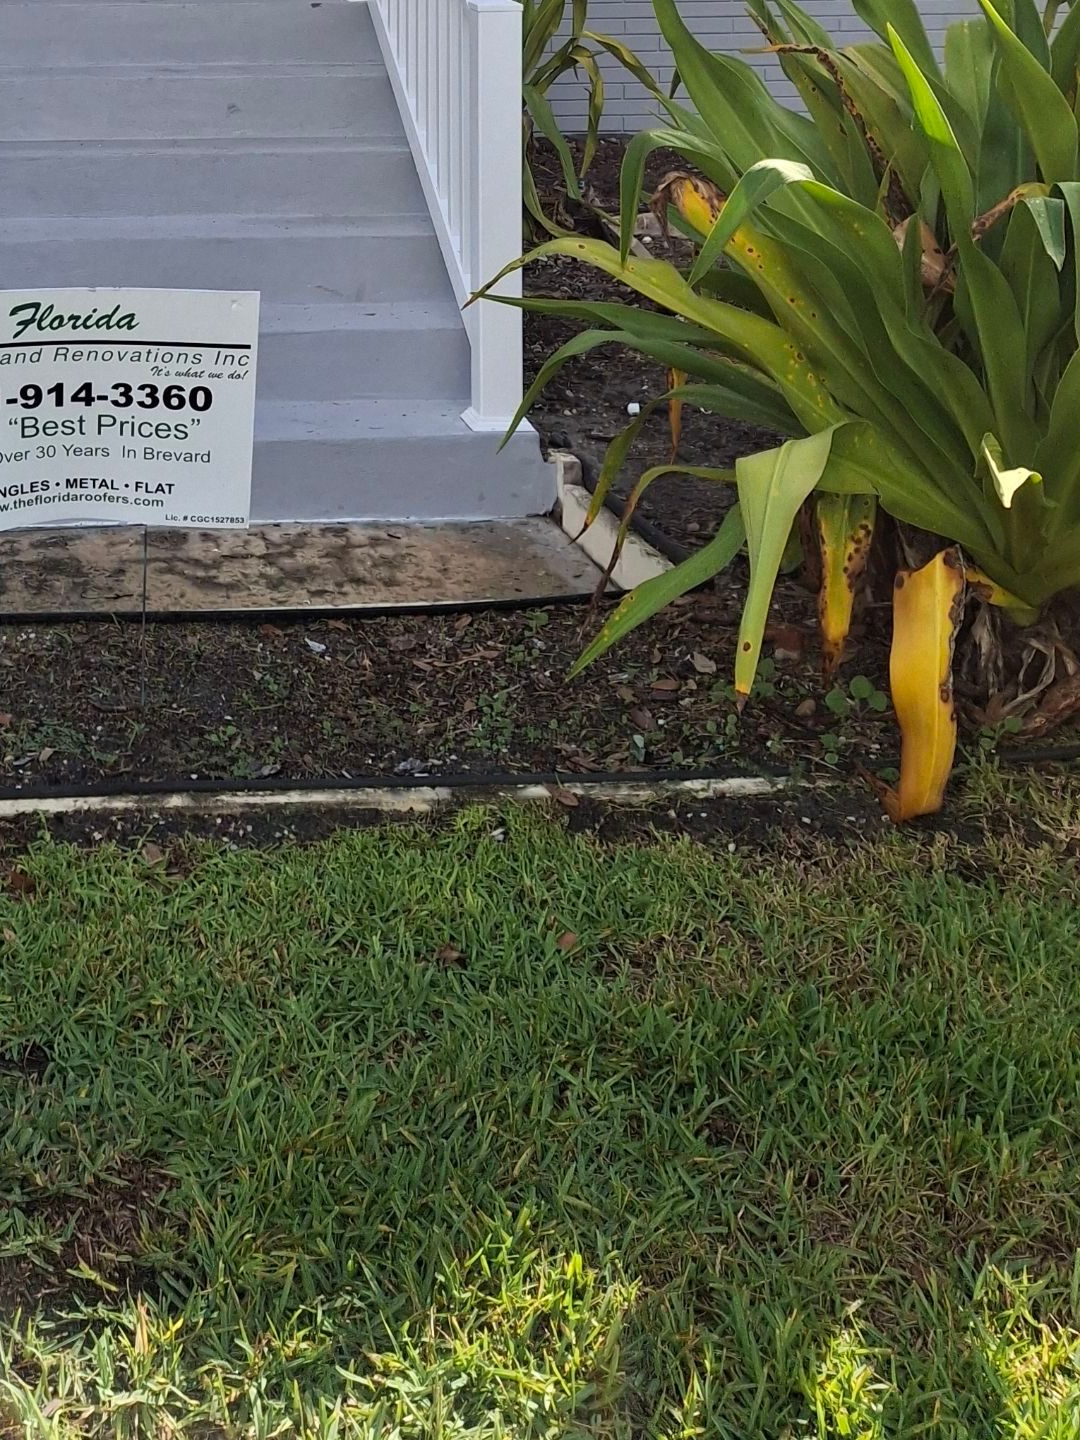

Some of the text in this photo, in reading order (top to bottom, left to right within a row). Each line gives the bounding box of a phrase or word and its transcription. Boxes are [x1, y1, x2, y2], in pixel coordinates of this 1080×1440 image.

[9, 301, 140, 339] Florida
[0, 347, 43, 366] and
[53, 346, 203, 365] Renovations
[214, 350, 250, 367] Inc
[150, 365, 249, 381] It's what we do!
[35, 444, 57, 459] 30
[62, 444, 110, 458] Years
[122, 445, 137, 459] In
[143, 446, 211, 464] Brevard
[65, 477, 120, 491] METAL
[134, 481, 175, 495] FLAT
[165, 513, 180, 522] Lic.
